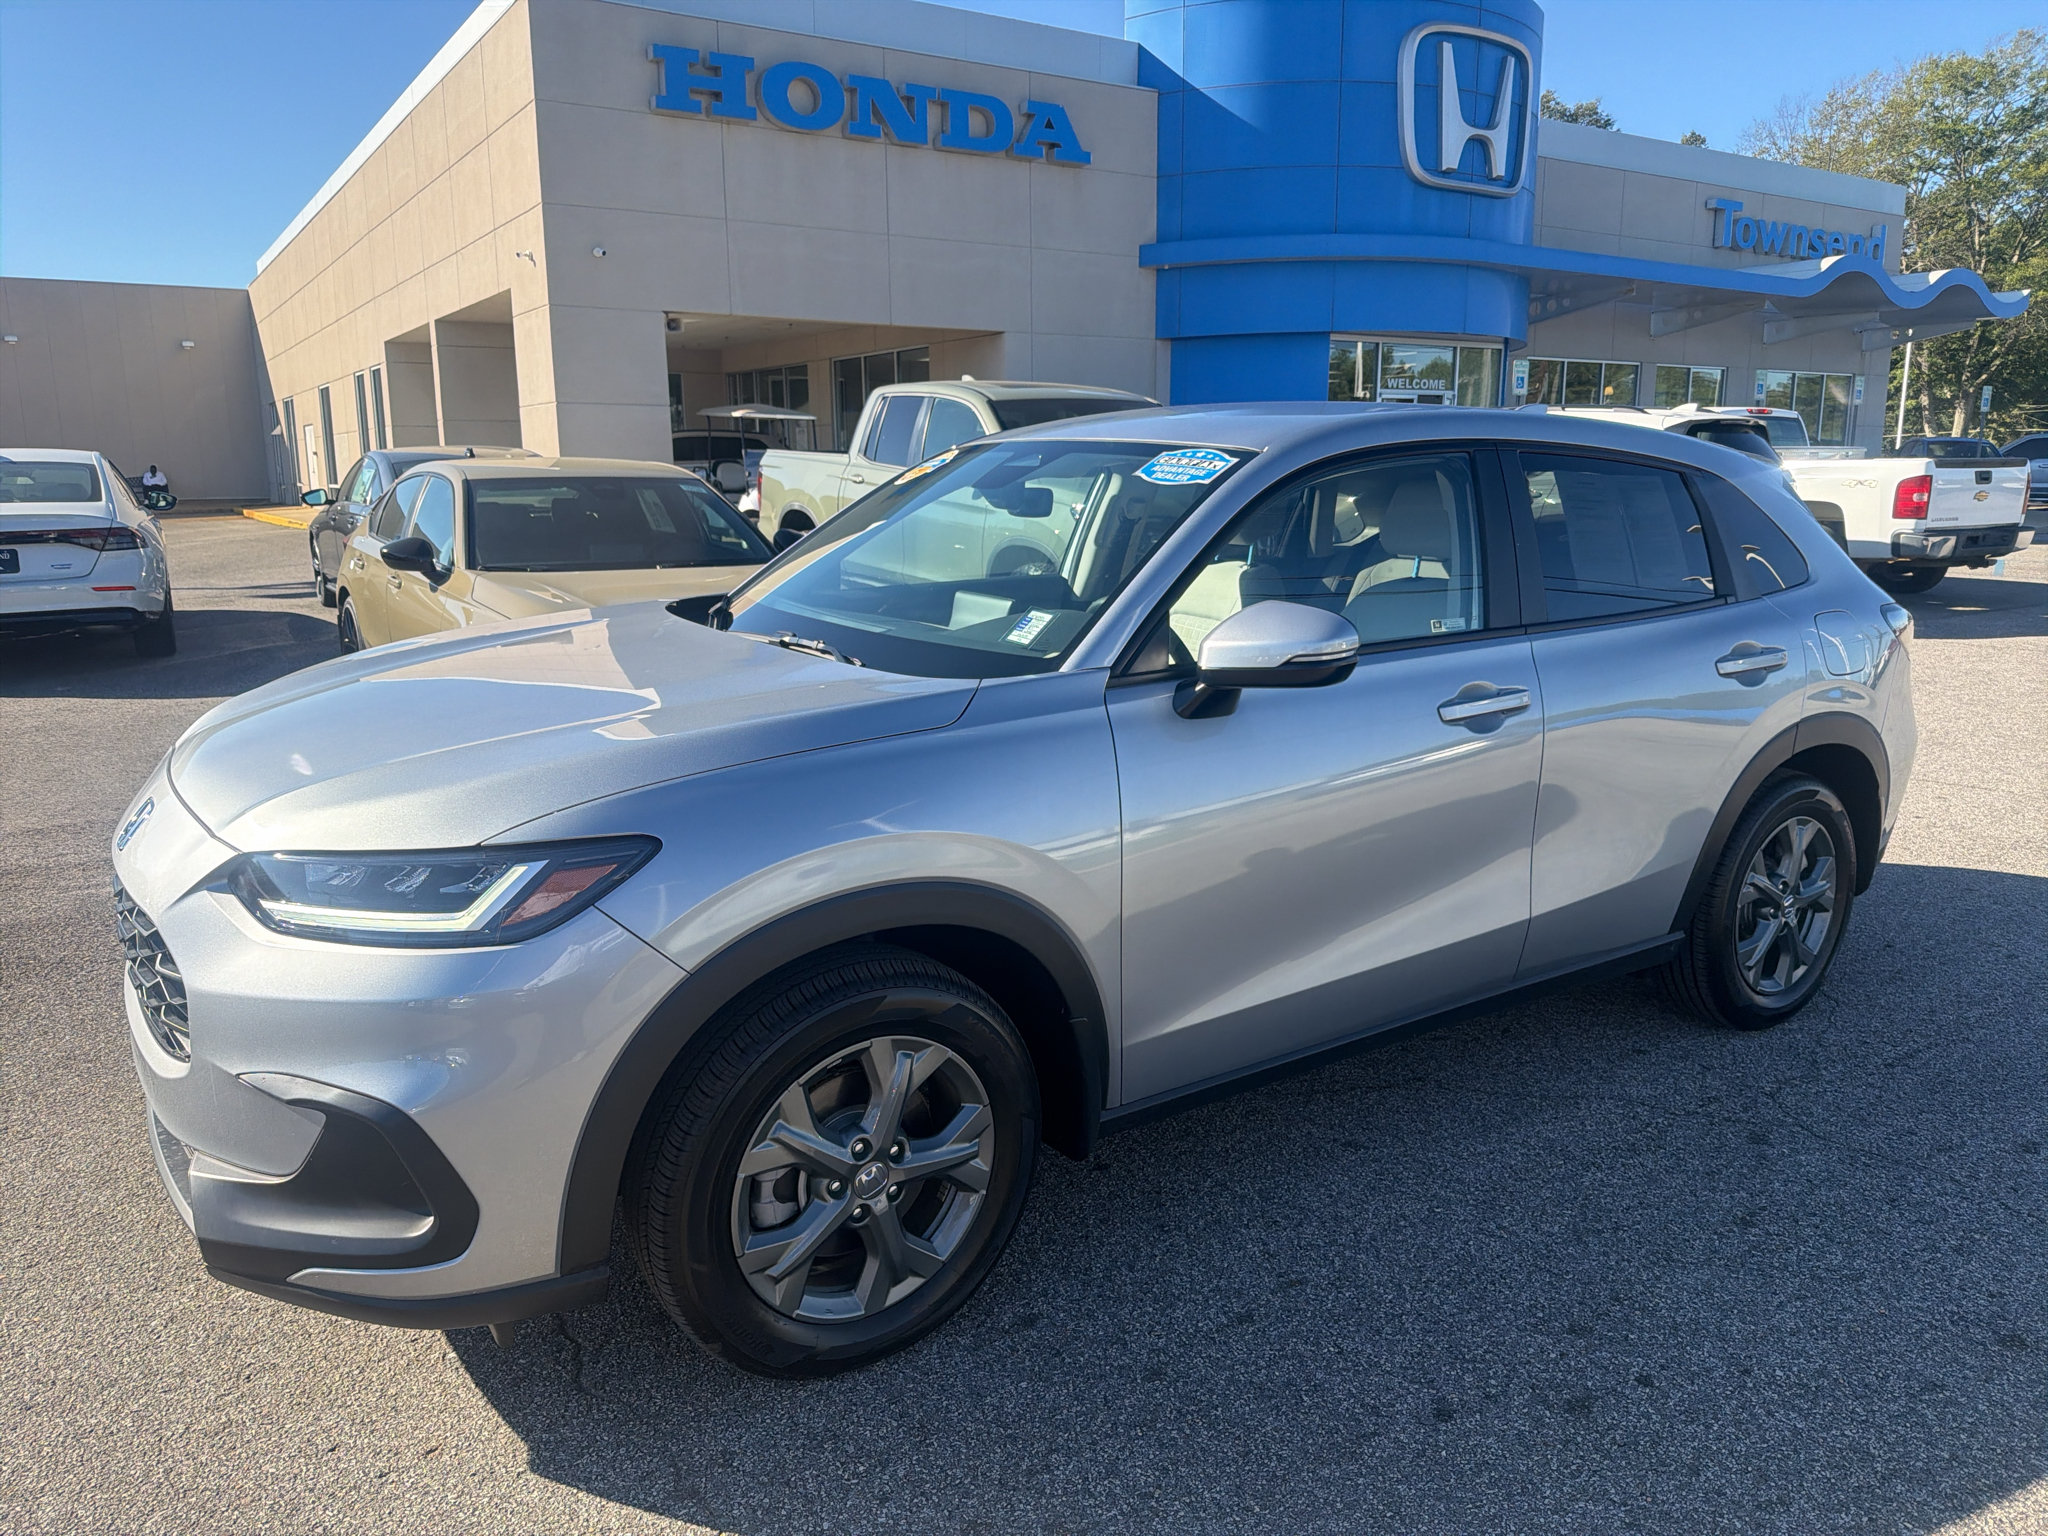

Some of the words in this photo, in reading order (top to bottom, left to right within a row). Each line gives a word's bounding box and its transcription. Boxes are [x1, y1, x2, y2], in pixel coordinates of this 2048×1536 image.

[647, 43, 1091, 167] HONDA
[1706, 197, 1888, 266] Townsend
[1387, 378, 1446, 390] WELCOME
[1151, 464, 1207, 476] ADVANTAGE
[1151, 472, 1191, 481] DEALER
